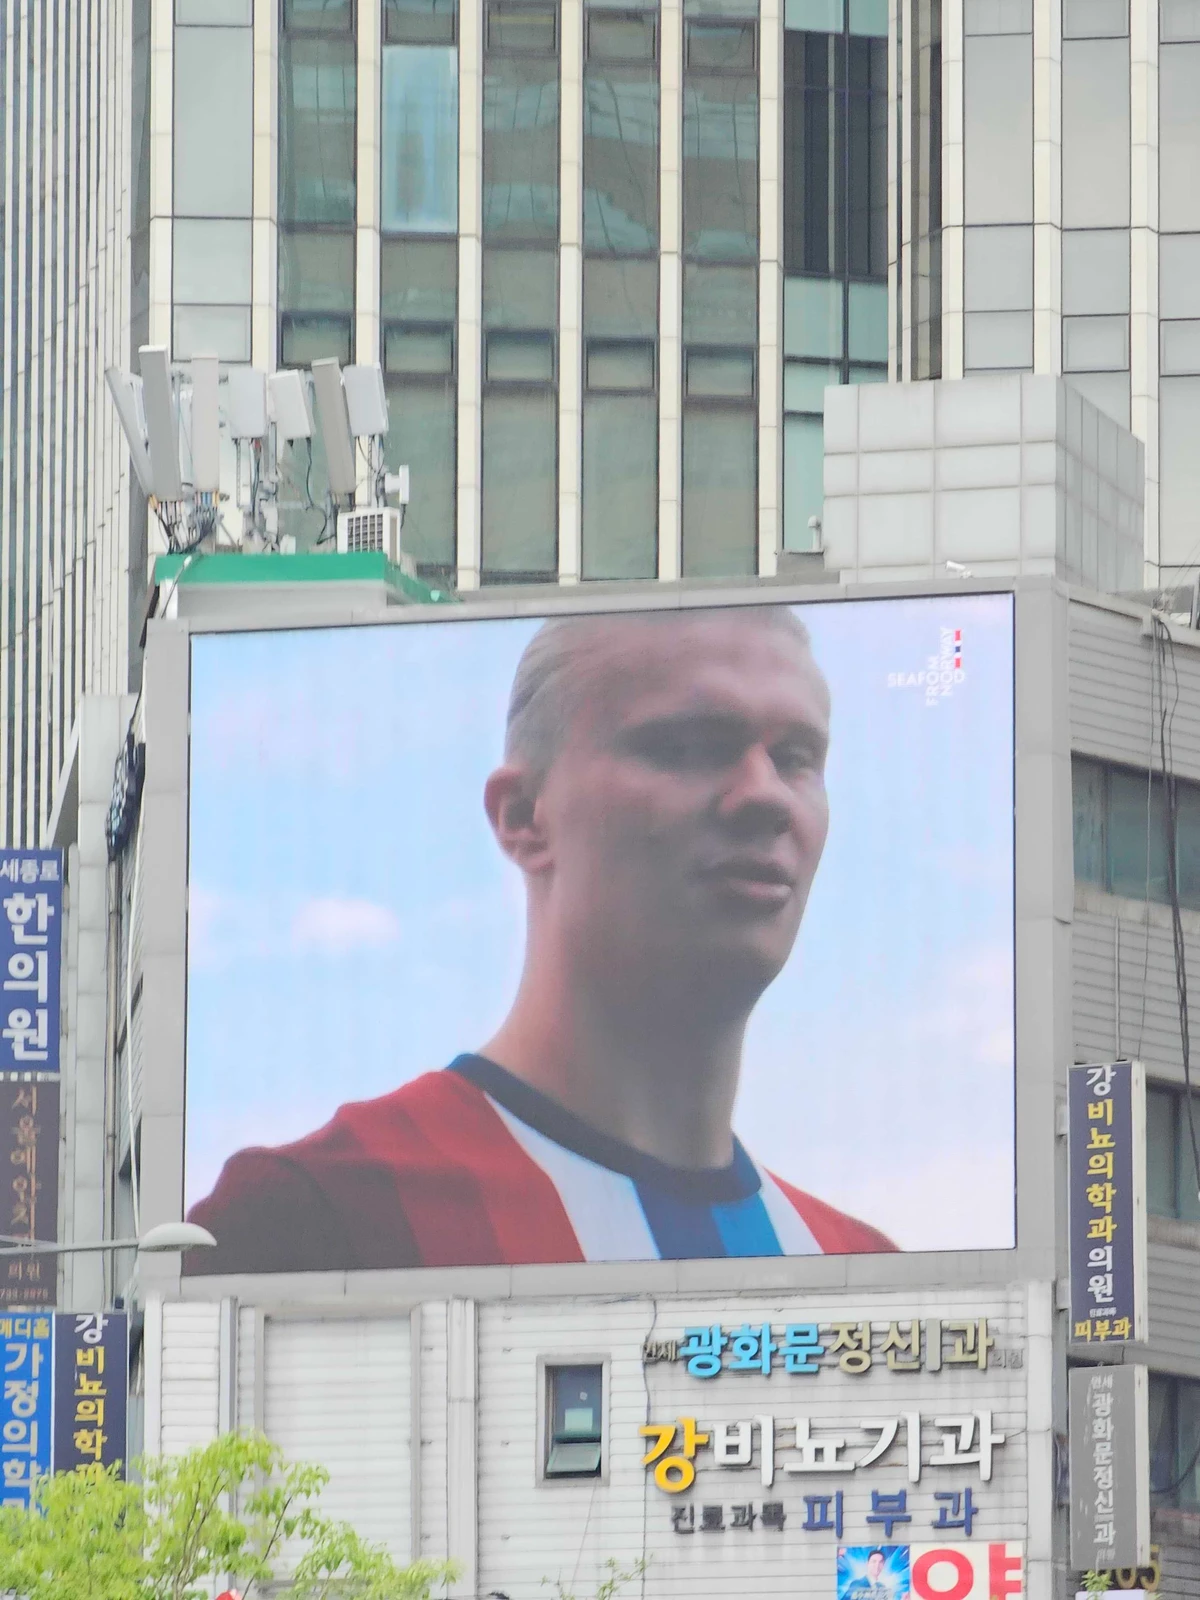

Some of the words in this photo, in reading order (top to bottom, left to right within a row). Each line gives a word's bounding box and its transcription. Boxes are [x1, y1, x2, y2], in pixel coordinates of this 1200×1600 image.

[887, 669, 966, 689] SEAFOOD
[0, 858, 60, 884] 세종로
[2, 892, 55, 1061] 한의원
[1085, 1065, 1118, 1304] 강비뇨의학과의원
[1074, 1316, 1133, 1342] 피부과
[638, 1409, 1006, 1494] 강비뇨기과
[801, 1486, 979, 1539] 피부과
